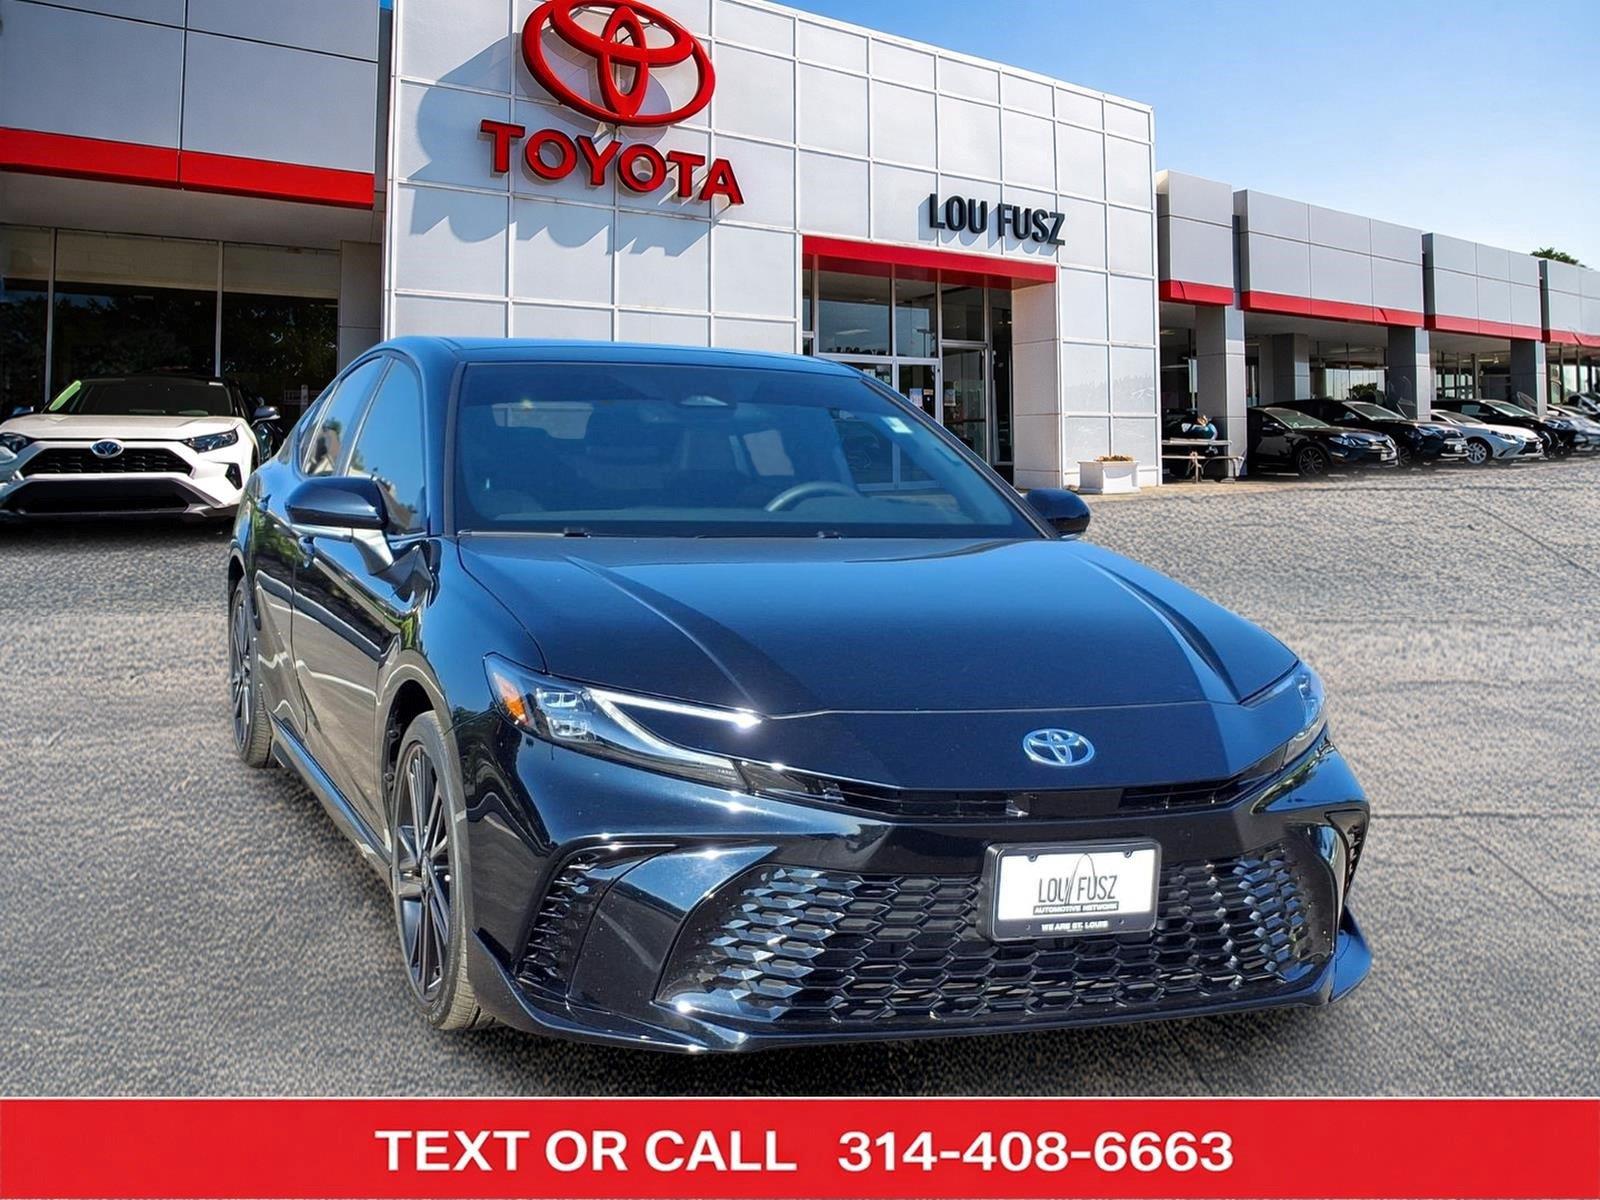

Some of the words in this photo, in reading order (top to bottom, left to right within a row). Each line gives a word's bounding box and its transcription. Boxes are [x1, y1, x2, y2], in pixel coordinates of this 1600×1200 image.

[480, 119, 744, 205] TOYOTA
[929, 193, 988, 234] LOU
[997, 203, 1066, 247] FUSZ
[1038, 877, 1069, 903] LOU
[1077, 874, 1118, 901] FUSZ
